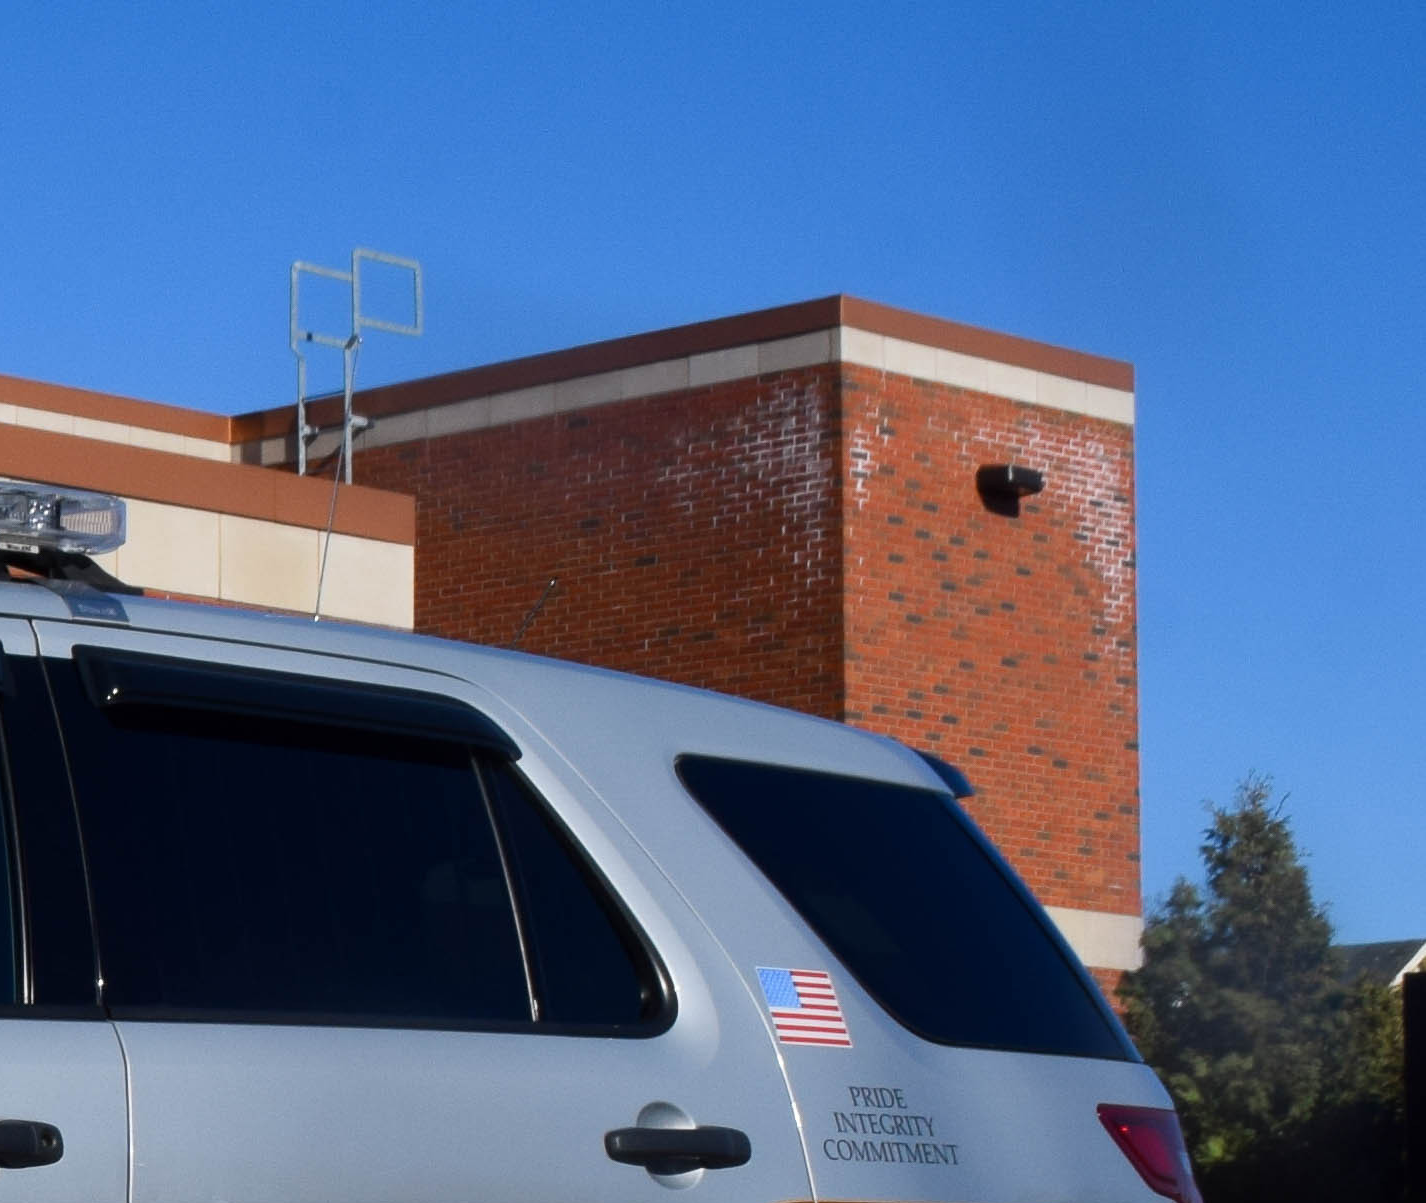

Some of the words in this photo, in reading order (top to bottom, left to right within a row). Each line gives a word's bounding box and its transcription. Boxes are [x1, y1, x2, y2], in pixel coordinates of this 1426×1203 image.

[848, 1086, 908, 1109] PRIDE
[833, 1112, 935, 1137] INTEGRITY
[823, 1139, 959, 1165] COMMITMENT
